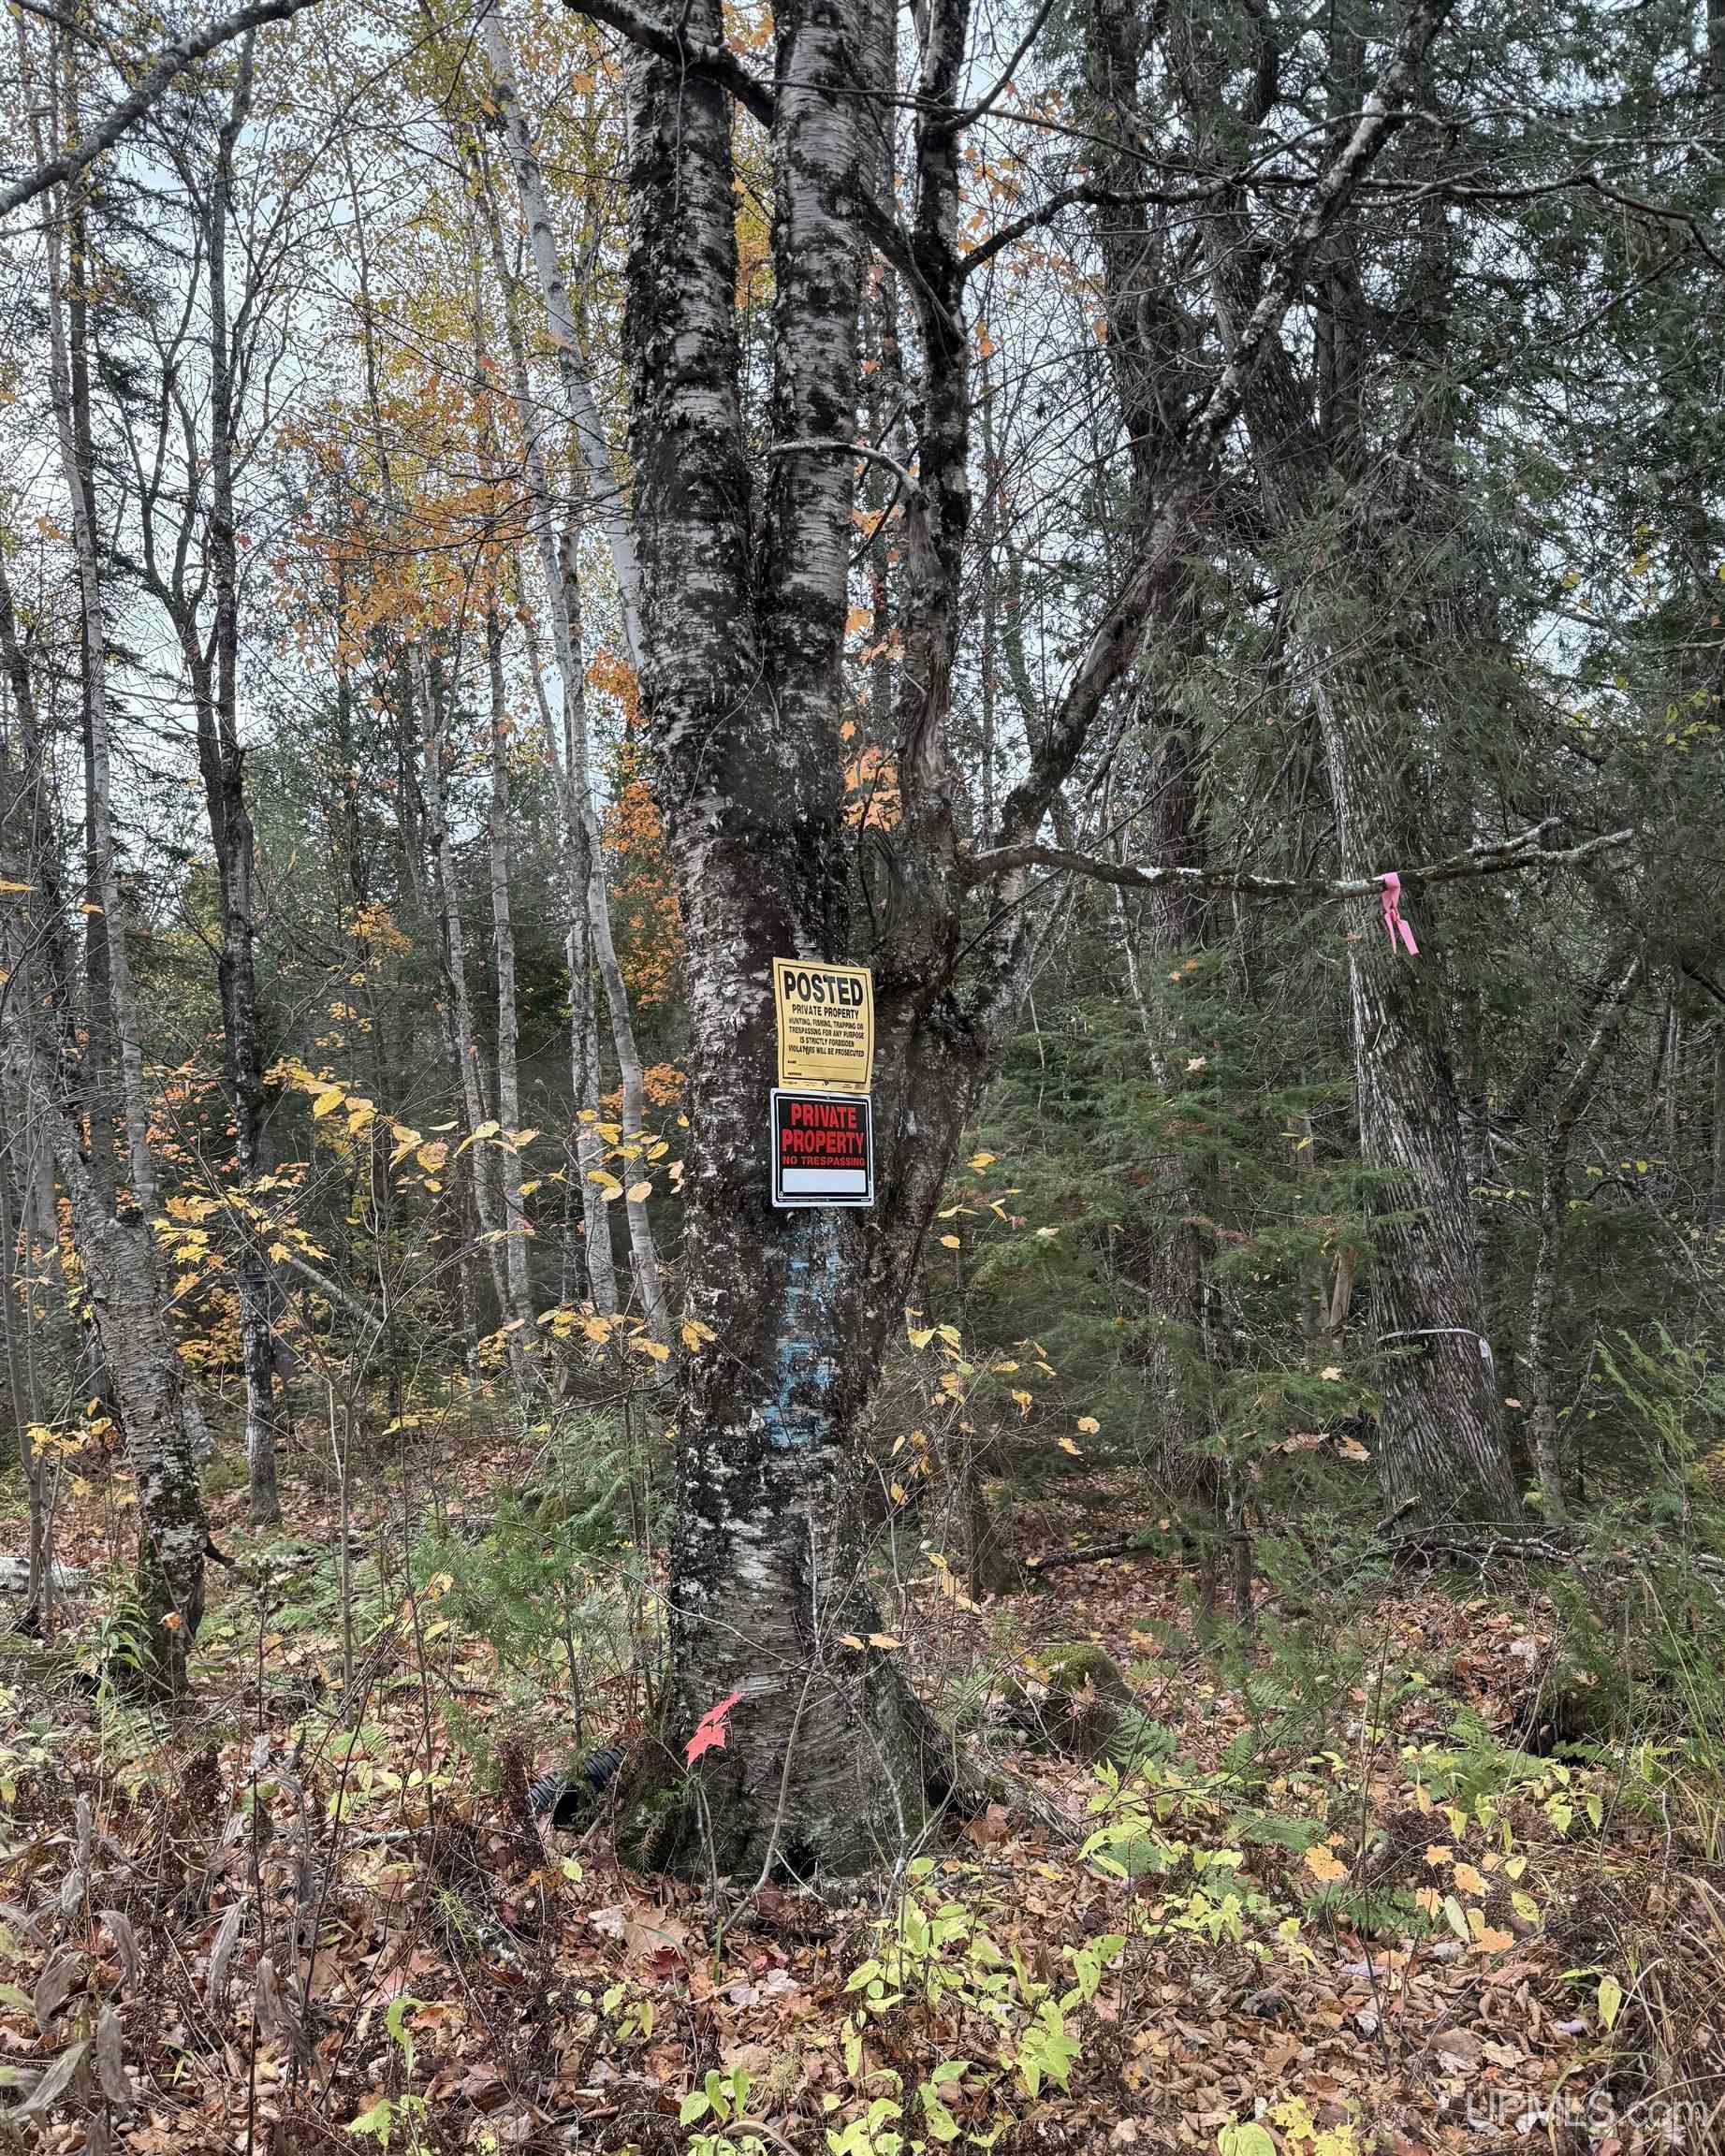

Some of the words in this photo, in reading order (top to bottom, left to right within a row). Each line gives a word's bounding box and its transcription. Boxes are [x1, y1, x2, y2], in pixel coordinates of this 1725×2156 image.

[783, 970, 863, 1006] POSTED
[792, 1004, 822, 1016] PRIVATE
[824, 1007, 859, 1019] PROPERTY
[833, 1021, 855, 1029] TRAPPING
[789, 1027, 822, 1035] TRESPASSING
[843, 1031, 864, 1040] PURPOSE
[806, 1037, 827, 1045] STRICTLY
[835, 1049, 864, 1057] PROSECUTED
[791, 1102, 857, 1129] PRIVATE
[782, 1128, 865, 1154] PROPERTY
[782, 1155, 797, 1165] NO
[800, 1156, 866, 1167] TRESPASSING
